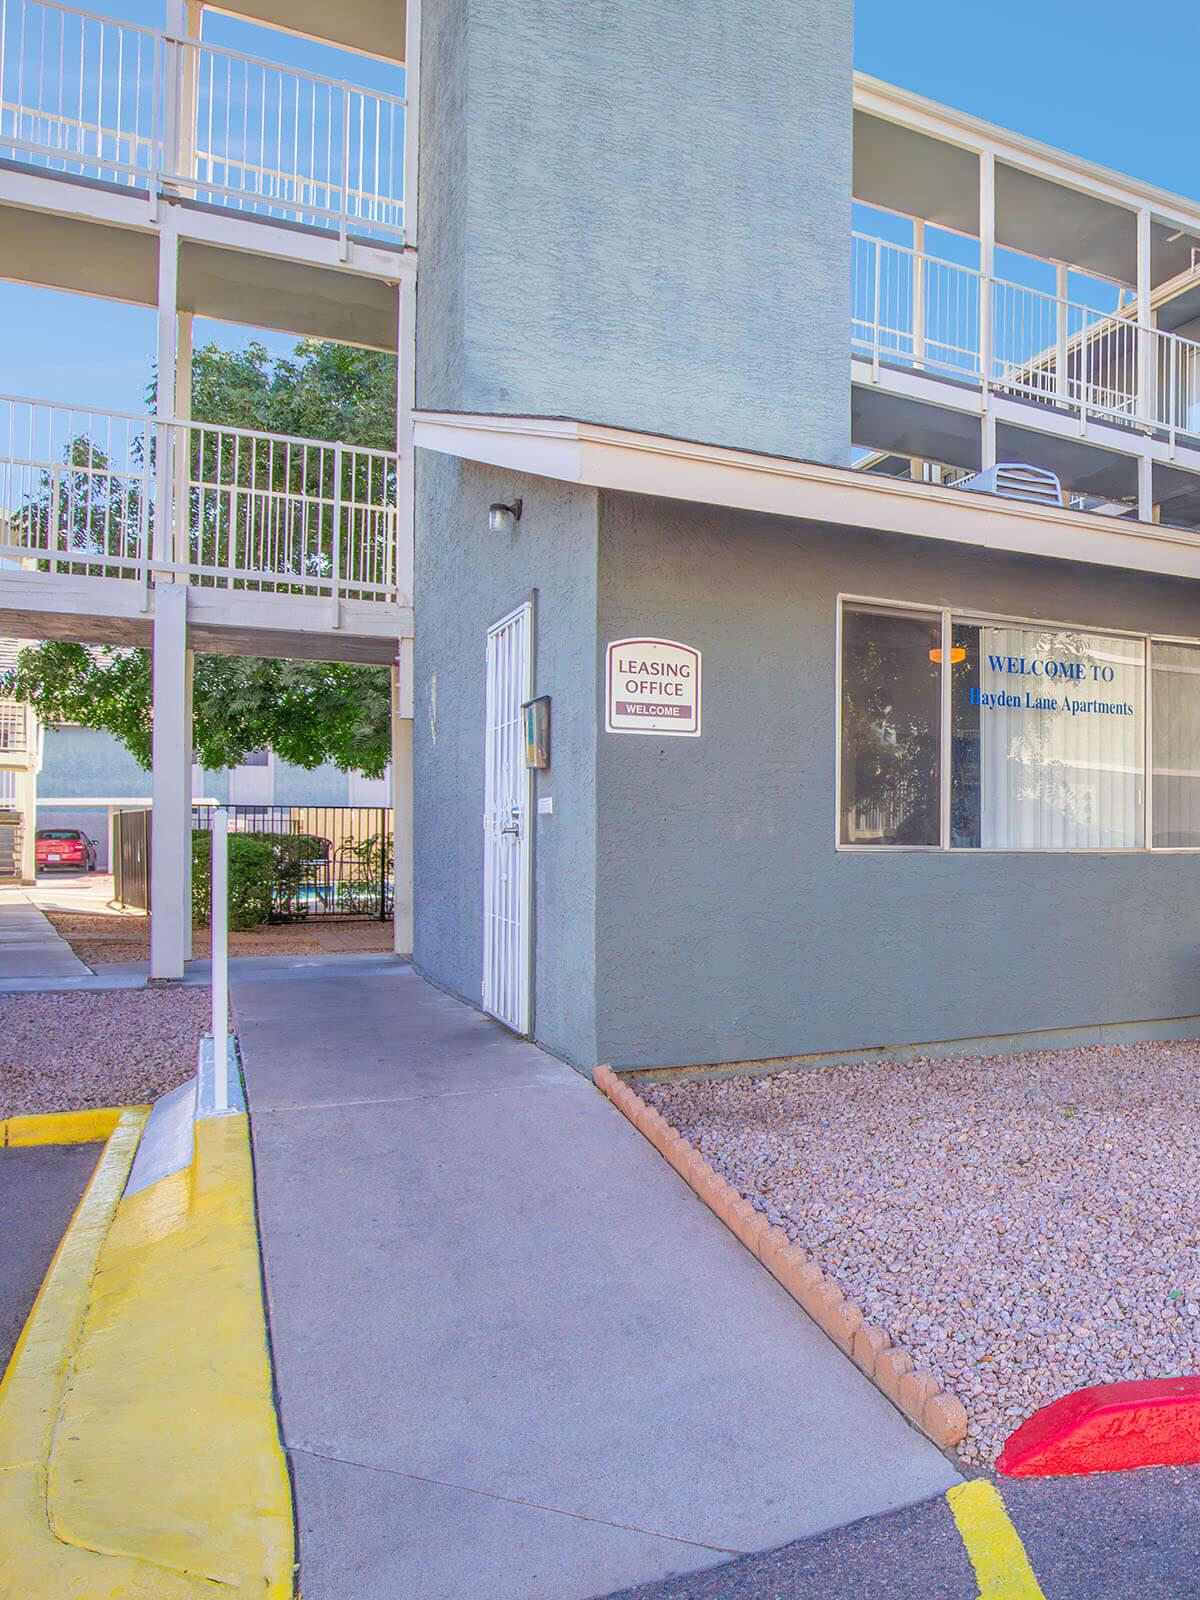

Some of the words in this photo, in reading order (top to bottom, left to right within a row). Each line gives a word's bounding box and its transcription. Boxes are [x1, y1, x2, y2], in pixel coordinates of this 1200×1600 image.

[619, 659, 691, 678] LEASING
[988, 655, 1087, 681] WELCOME
[1090, 665, 1115, 682] TO
[625, 680, 684, 697] OFFICE
[626, 704, 681, 716] WELCOME
[969, 687, 1022, 710] Hayden
[1025, 692, 1058, 711] Lane
[1062, 696, 1134, 716] Apartments
